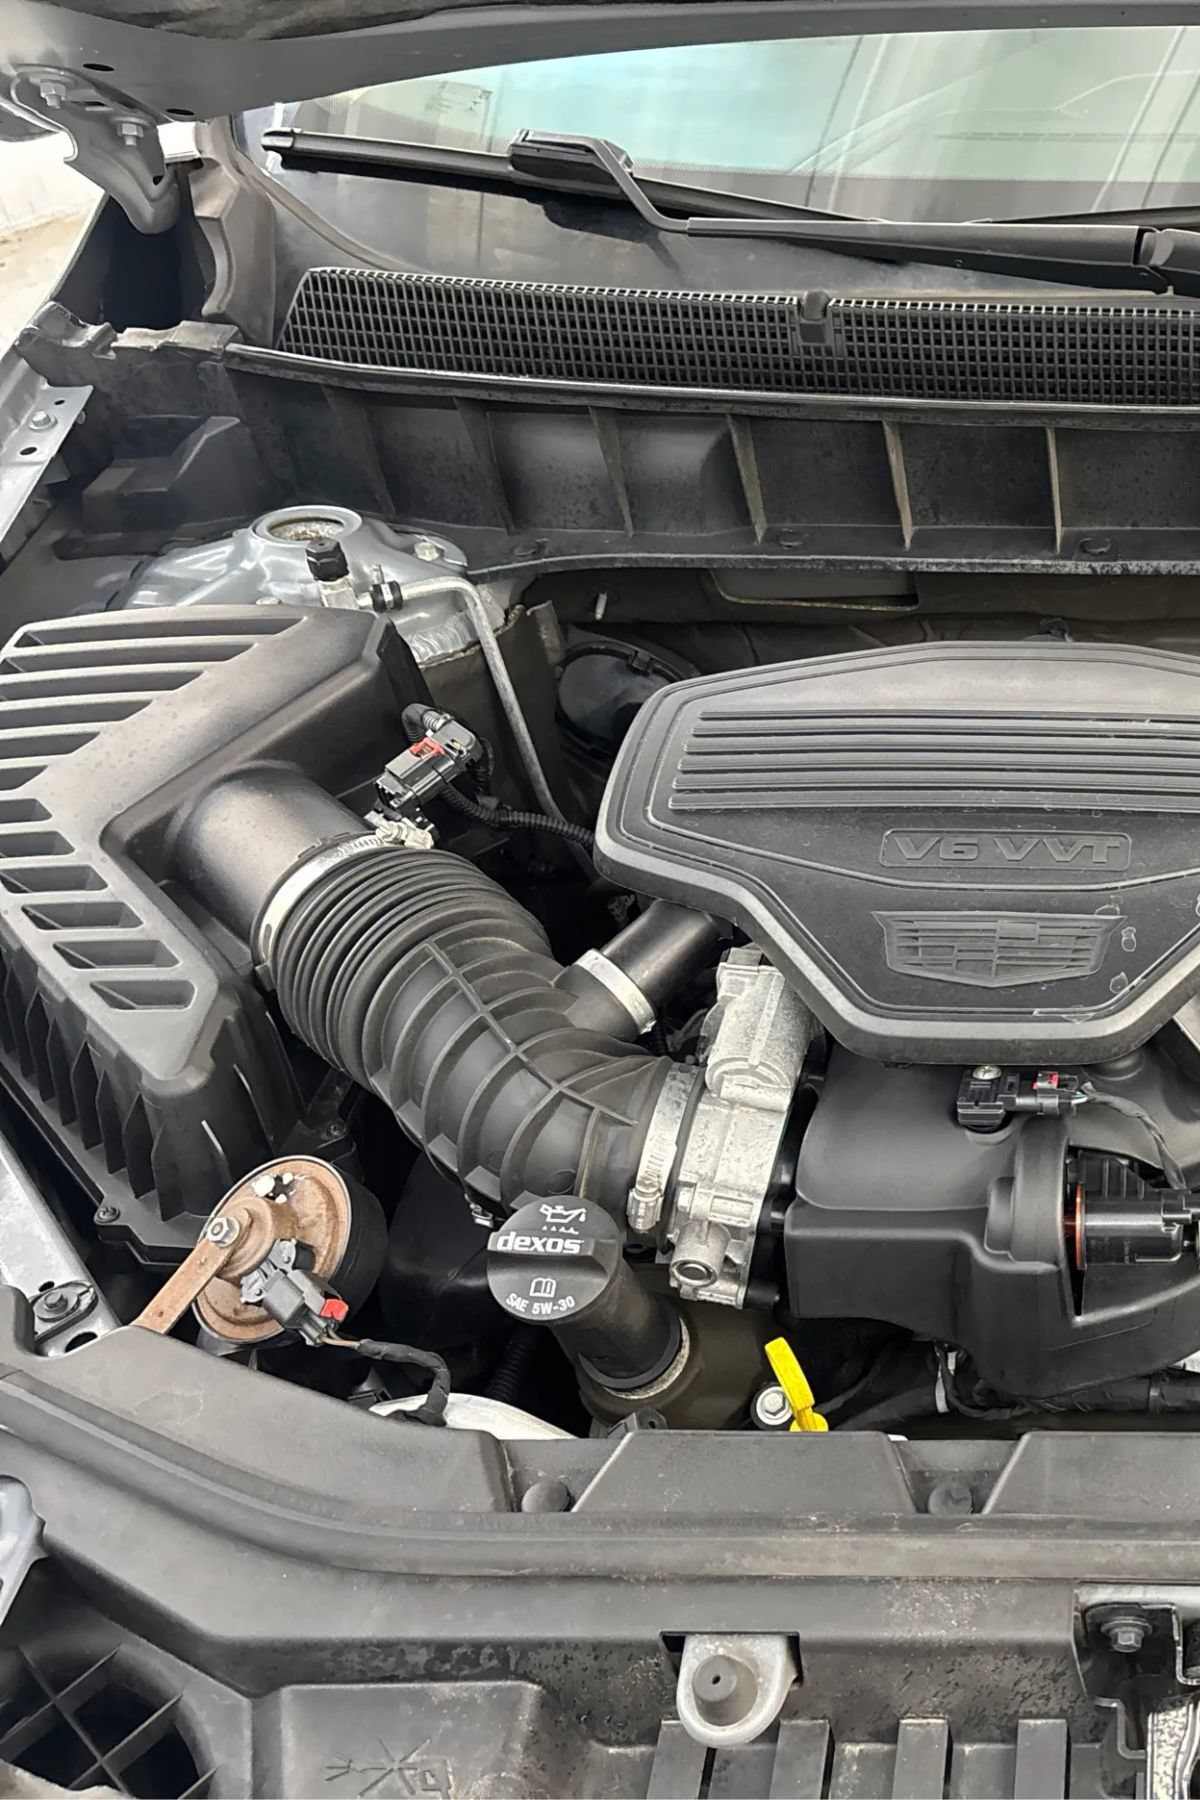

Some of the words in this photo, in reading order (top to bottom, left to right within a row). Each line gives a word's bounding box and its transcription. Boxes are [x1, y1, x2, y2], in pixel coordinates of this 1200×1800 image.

[894, 836, 979, 861] V6
[993, 837, 1121, 864] VVT
[496, 1231, 582, 1254] dexos
[505, 1293, 529, 1312] SAE
[531, 1296, 576, 1315] 5W-30
